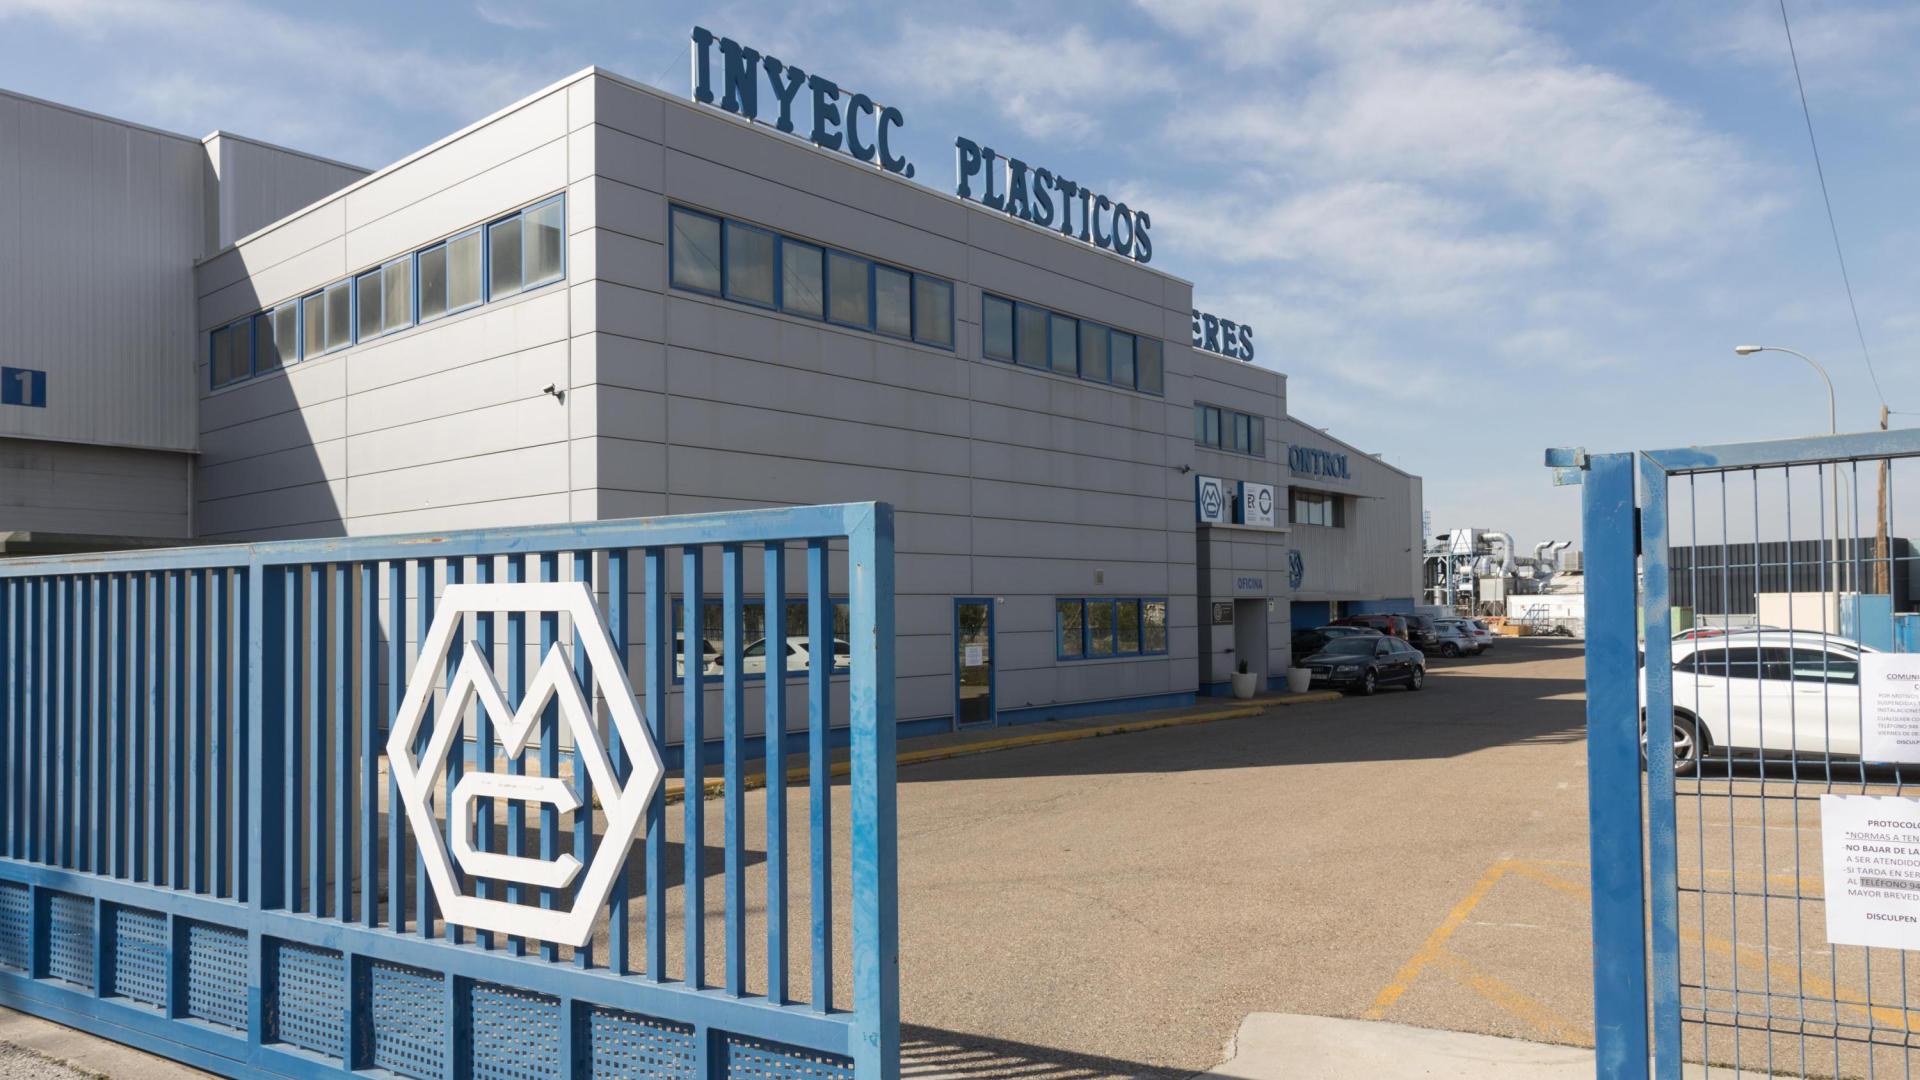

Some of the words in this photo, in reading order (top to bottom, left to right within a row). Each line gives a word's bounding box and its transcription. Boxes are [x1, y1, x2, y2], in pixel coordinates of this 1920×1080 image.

[692, 26, 915, 178] INYECC.
[955, 136, 1152, 263] PLASTICOS
[15, 370, 32, 405] 1
[1862, 845, 1891, 853] BAJAR
[1856, 867, 1887, 876] TARDA
[1847, 877, 1858, 885] AL
[1848, 889, 1881, 898] MAYOR
[1866, 912, 1917, 923] DISCULPEN
